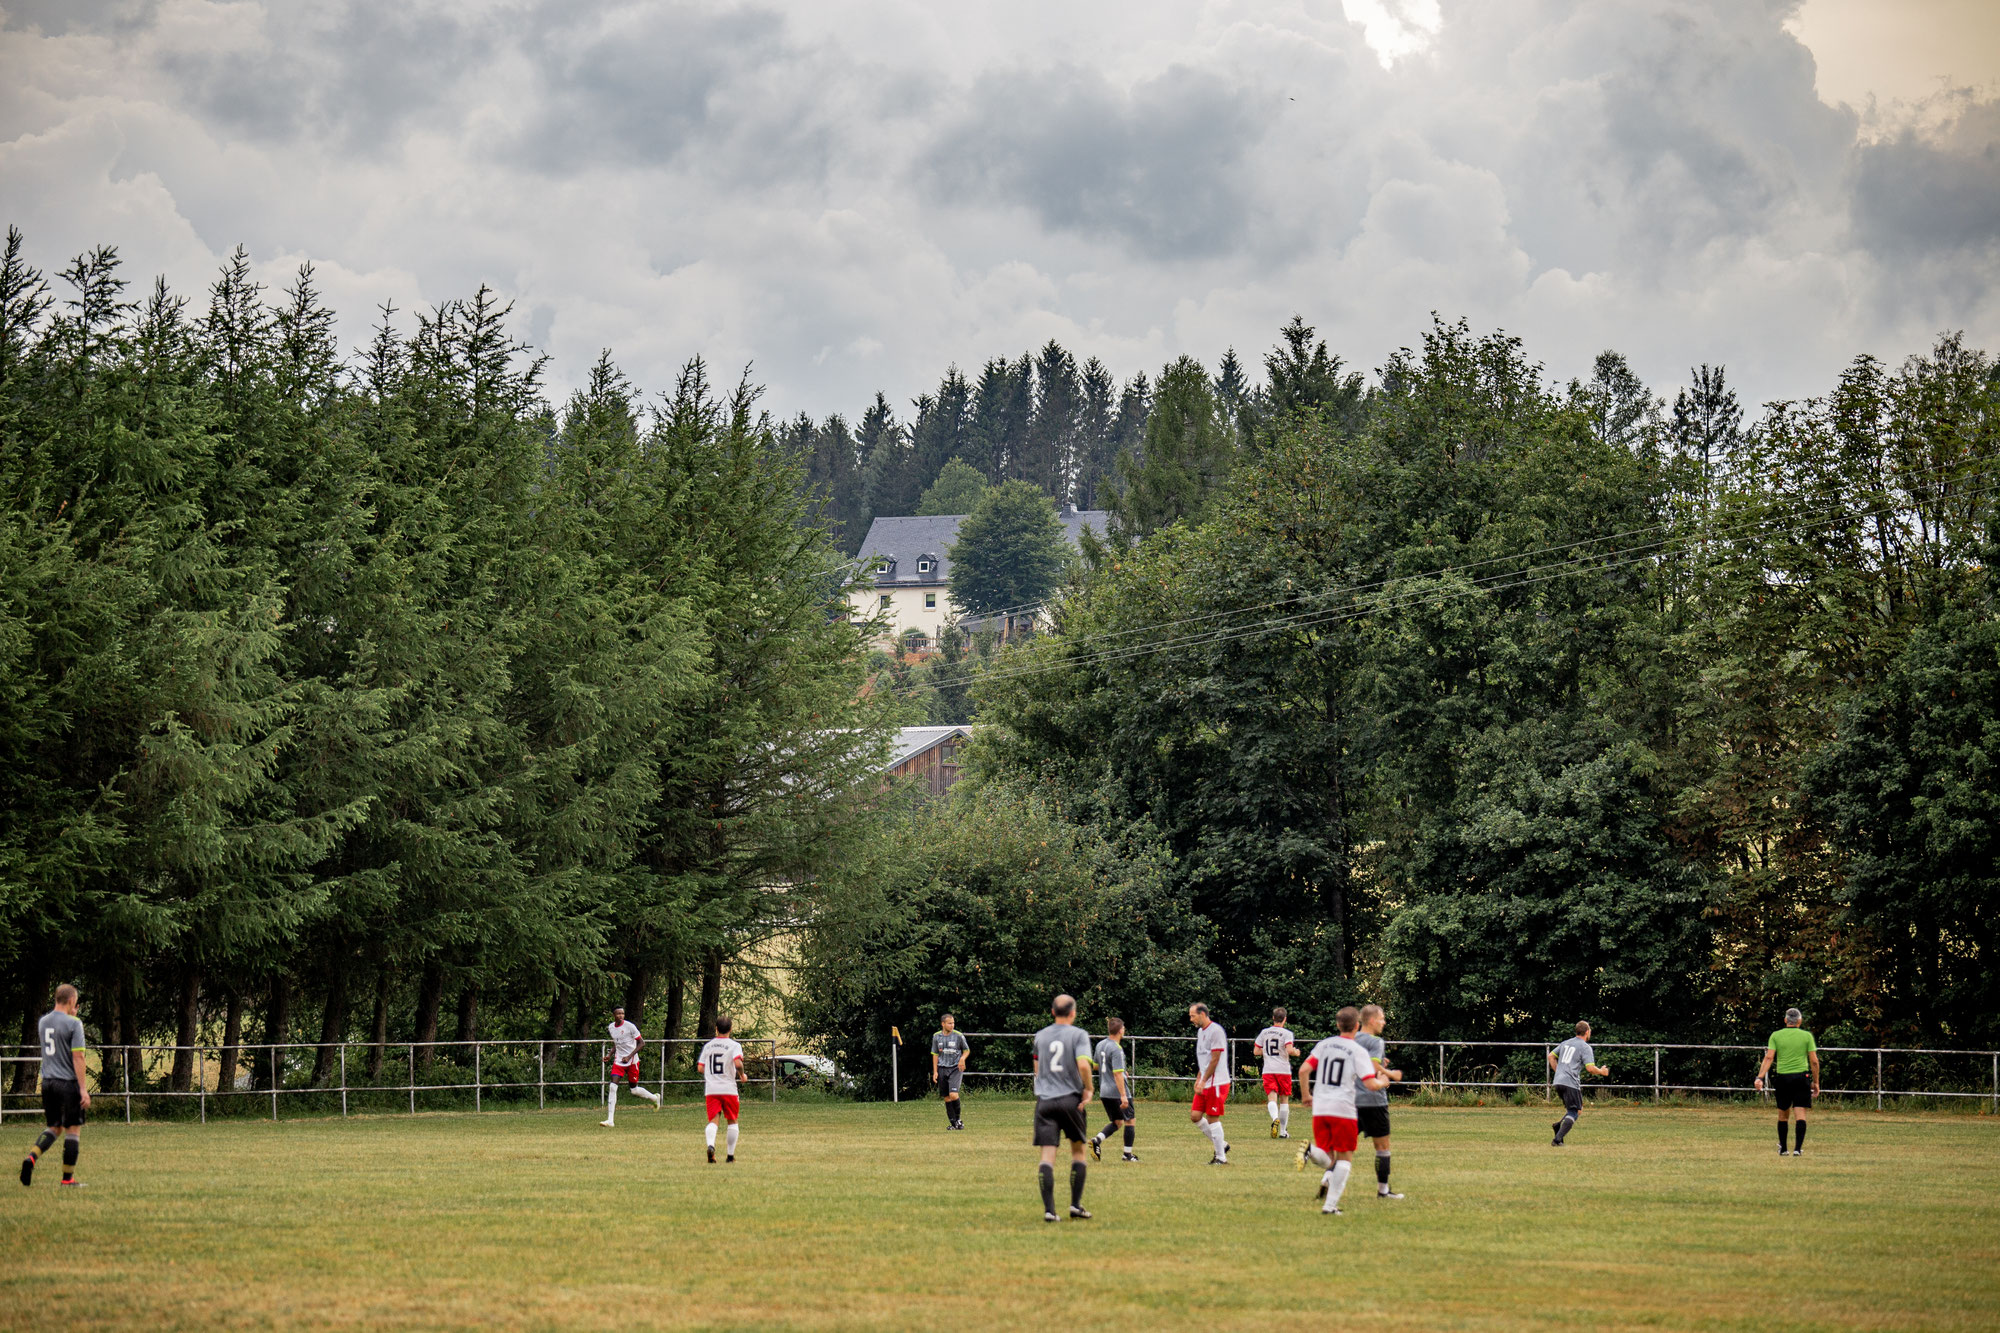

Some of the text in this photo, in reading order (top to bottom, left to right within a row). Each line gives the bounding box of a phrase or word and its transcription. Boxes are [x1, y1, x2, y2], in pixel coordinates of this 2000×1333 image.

[45, 1028, 56, 1056] 5
[1265, 1038, 1280, 1056] 12
[1561, 1045, 1576, 1064] 10
[709, 1053, 725, 1075] 16
[1049, 1040, 1064, 1072] 2
[1322, 1056, 1345, 1087] 10
